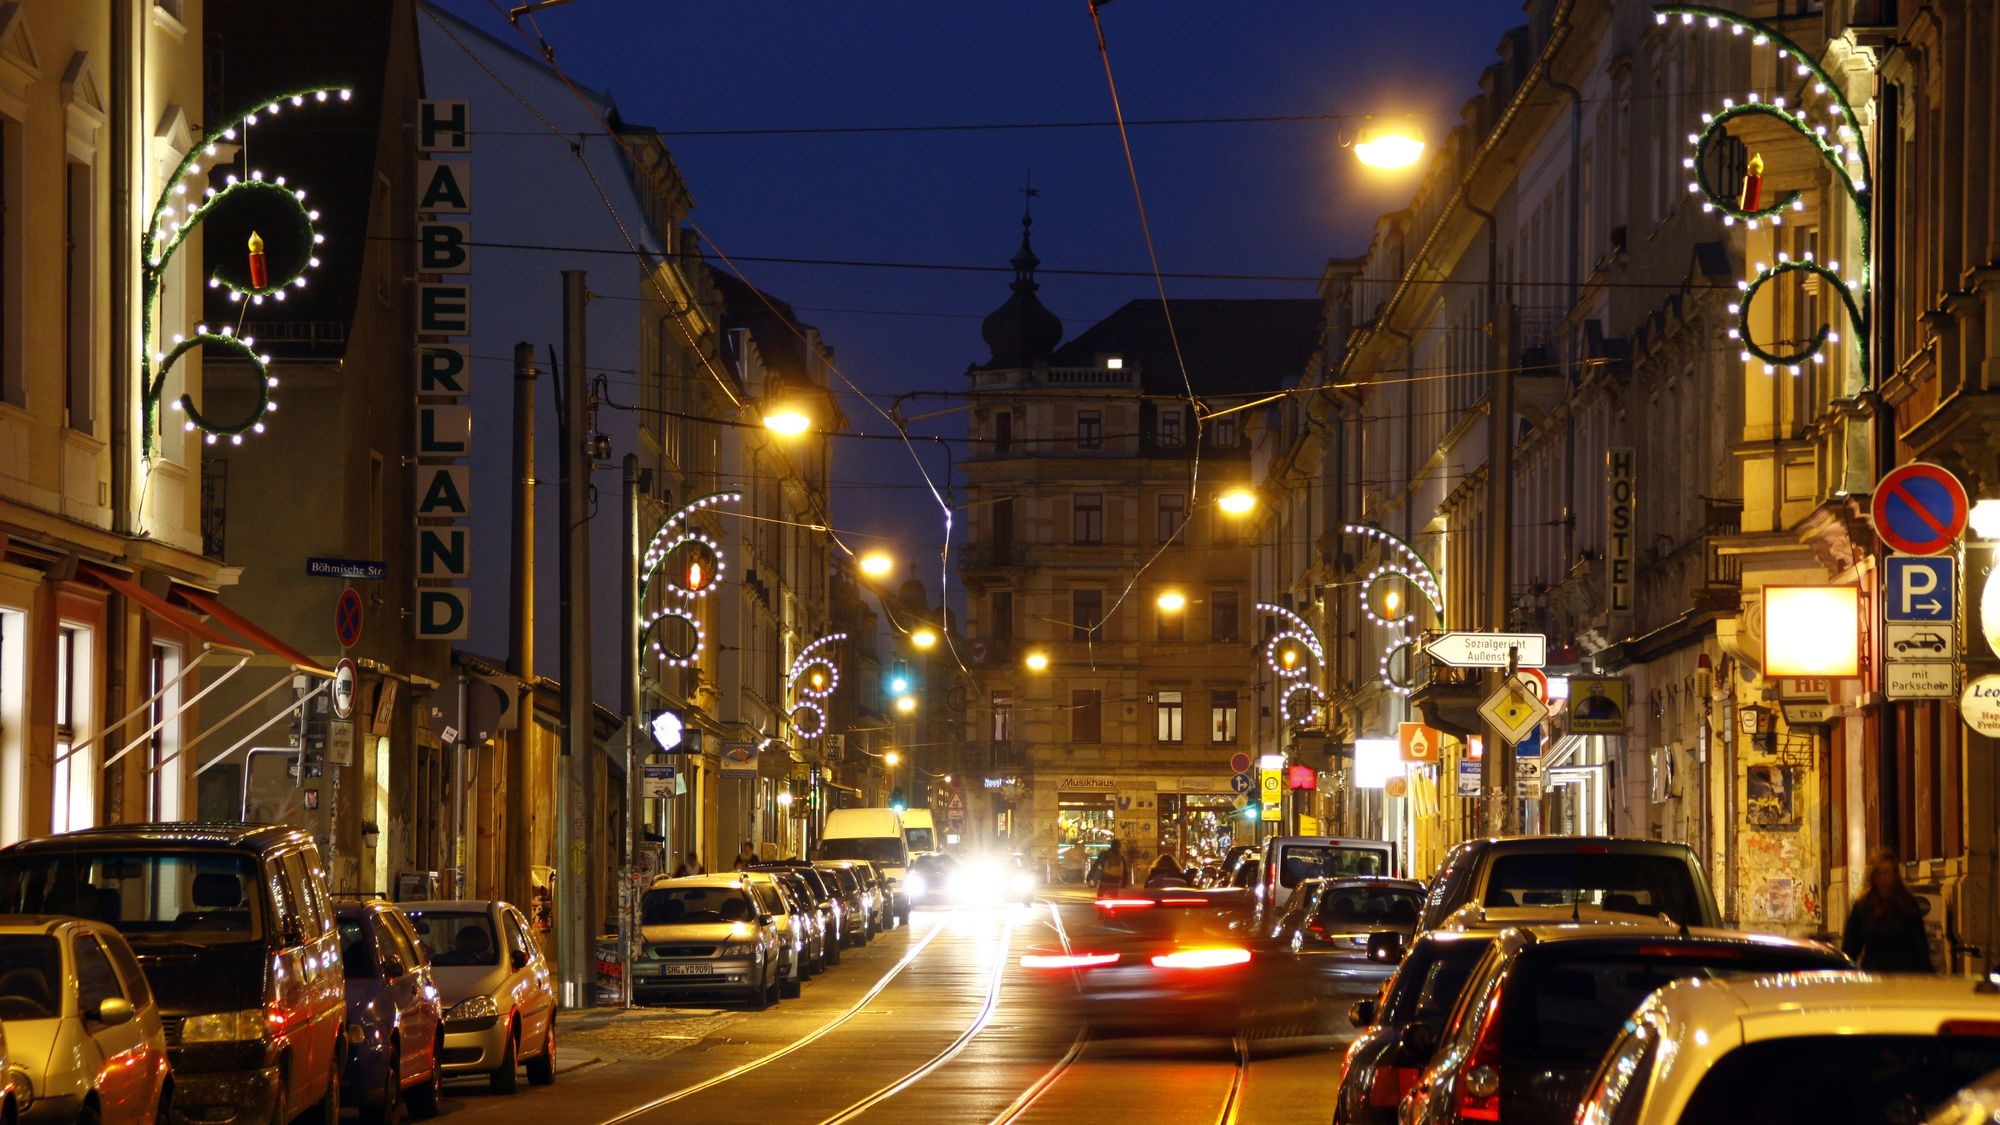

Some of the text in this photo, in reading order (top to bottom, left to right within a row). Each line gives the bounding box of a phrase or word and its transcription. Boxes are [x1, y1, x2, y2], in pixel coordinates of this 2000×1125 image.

[419, 103, 467, 635] HABERLAND
[1612, 452, 1630, 611] HOSTEL
[312, 562, 384, 576] Böhmische Str.
[1902, 564, 1938, 614] P
[1464, 638, 1526, 652] Sozialgericht
[1467, 650, 1523, 662] Außenste
[1911, 670, 1928, 680] mit
[1891, 681, 1949, 691] Parkschein
[1060, 778, 1115, 788] Musikhaus
